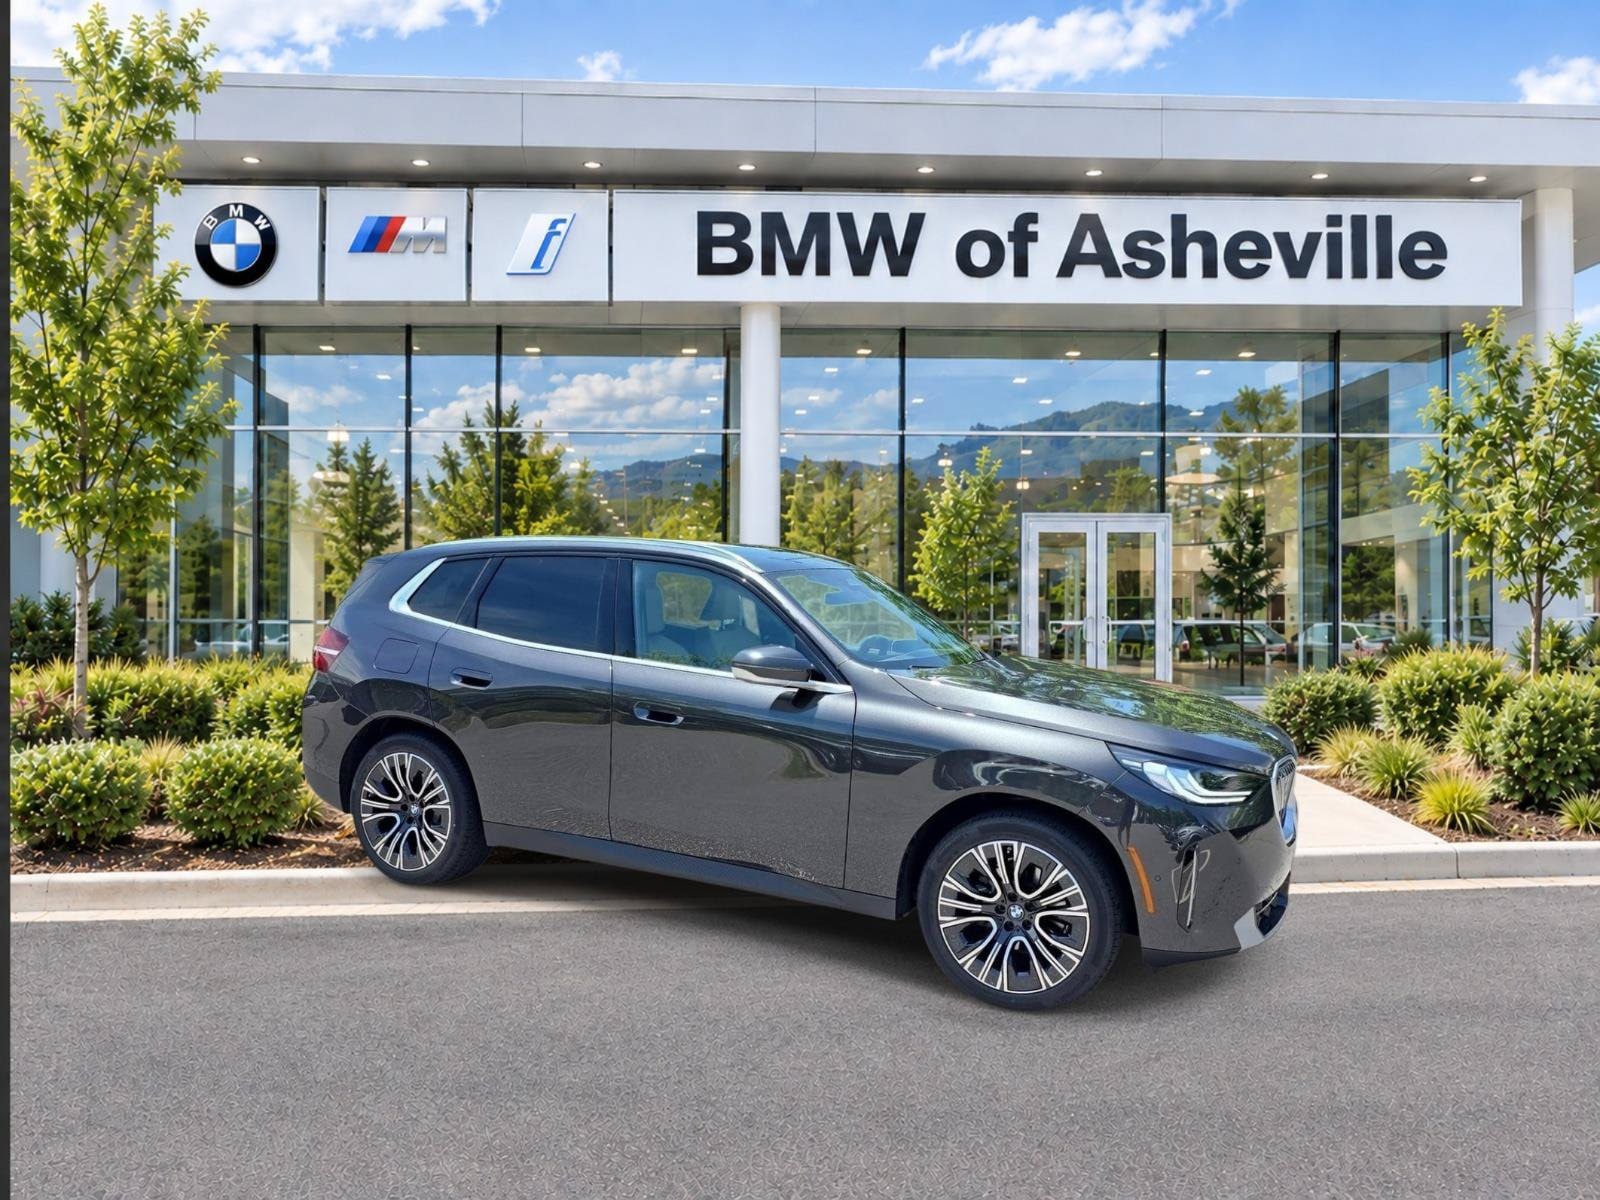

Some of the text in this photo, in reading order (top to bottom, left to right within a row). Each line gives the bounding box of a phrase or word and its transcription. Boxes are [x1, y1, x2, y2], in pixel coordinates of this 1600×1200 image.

[203, 204, 271, 231] BMW
[389, 216, 448, 253] M
[697, 211, 1447, 279] BMW of Asheville
